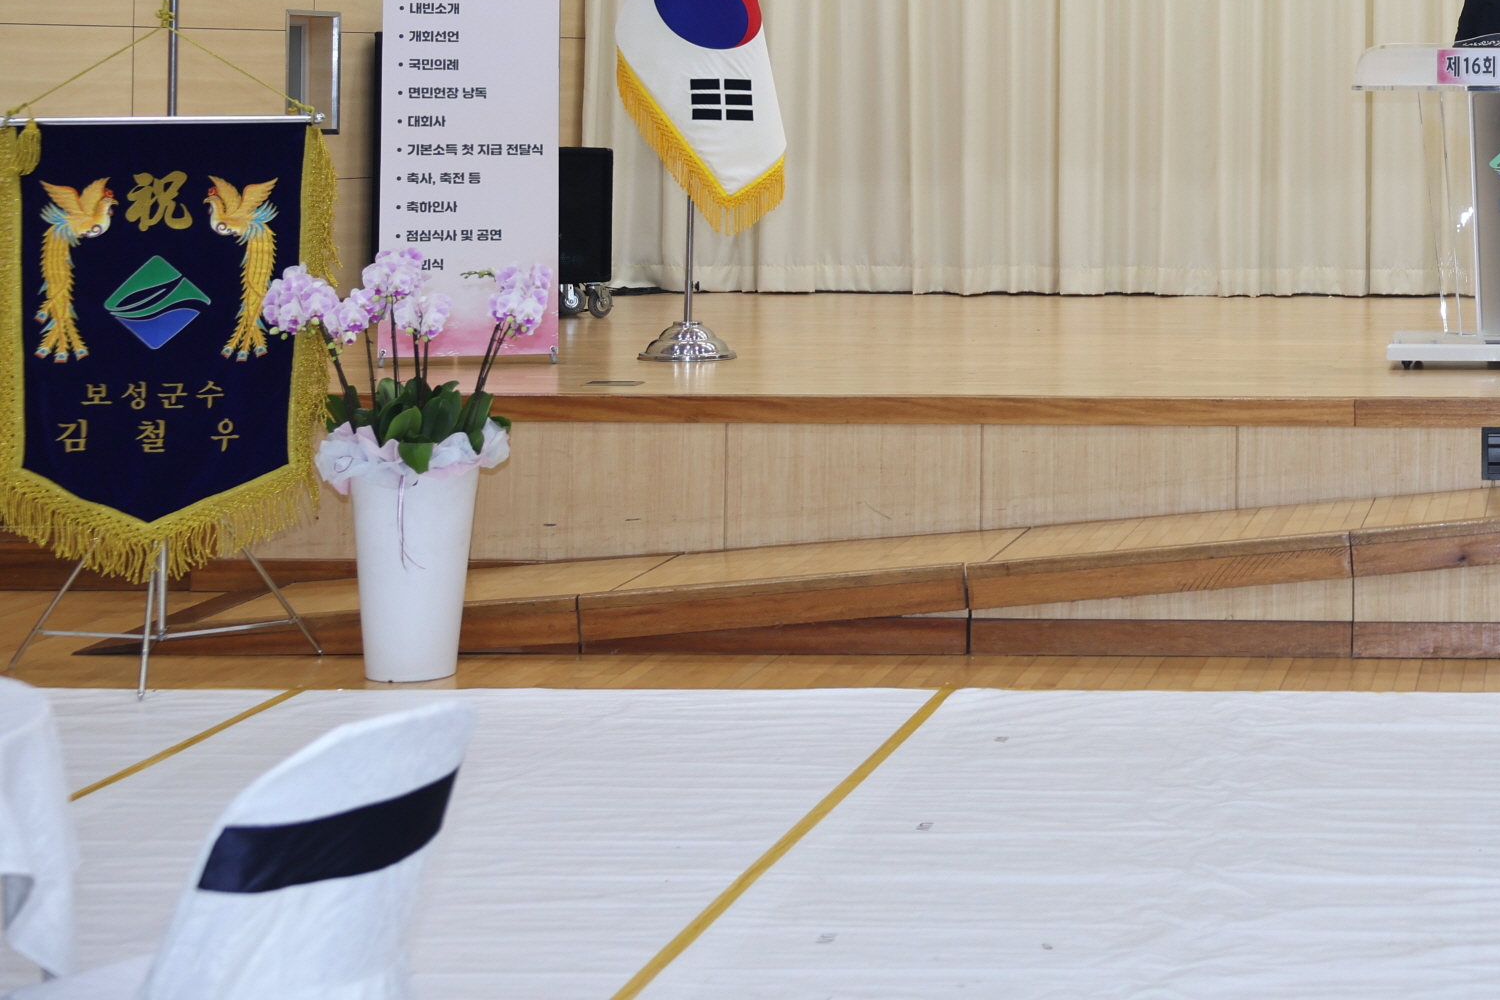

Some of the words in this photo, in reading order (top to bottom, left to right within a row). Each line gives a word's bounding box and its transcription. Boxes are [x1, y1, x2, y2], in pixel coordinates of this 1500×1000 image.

[409, 2, 460, 15] 내빈소개
[409, 30, 460, 43] 개회선언
[408, 58, 459, 71] 국민의례
[1445, 55, 1497, 78] 제16회
[408, 86, 459, 99] 면민헌장
[462, 87, 487, 100] 낭독
[407, 115, 446, 128] 대회사
[407, 143, 458, 156] 기본소득
[461, 143, 474, 156] 첫
[477, 143, 503, 156] 지급
[506, 143, 544, 156] 전달식
[406, 172, 436, 186] 축사,
[439, 172, 465, 185] 축전
[468, 172, 481, 185] 등
[124, 169, 194, 232] 祝
[406, 200, 458, 214] 축하인사
[406, 229, 458, 243] 점심식사
[460, 229, 473, 242] 및
[476, 229, 502, 242] 공연
[80, 380, 226, 410] 보성군수
